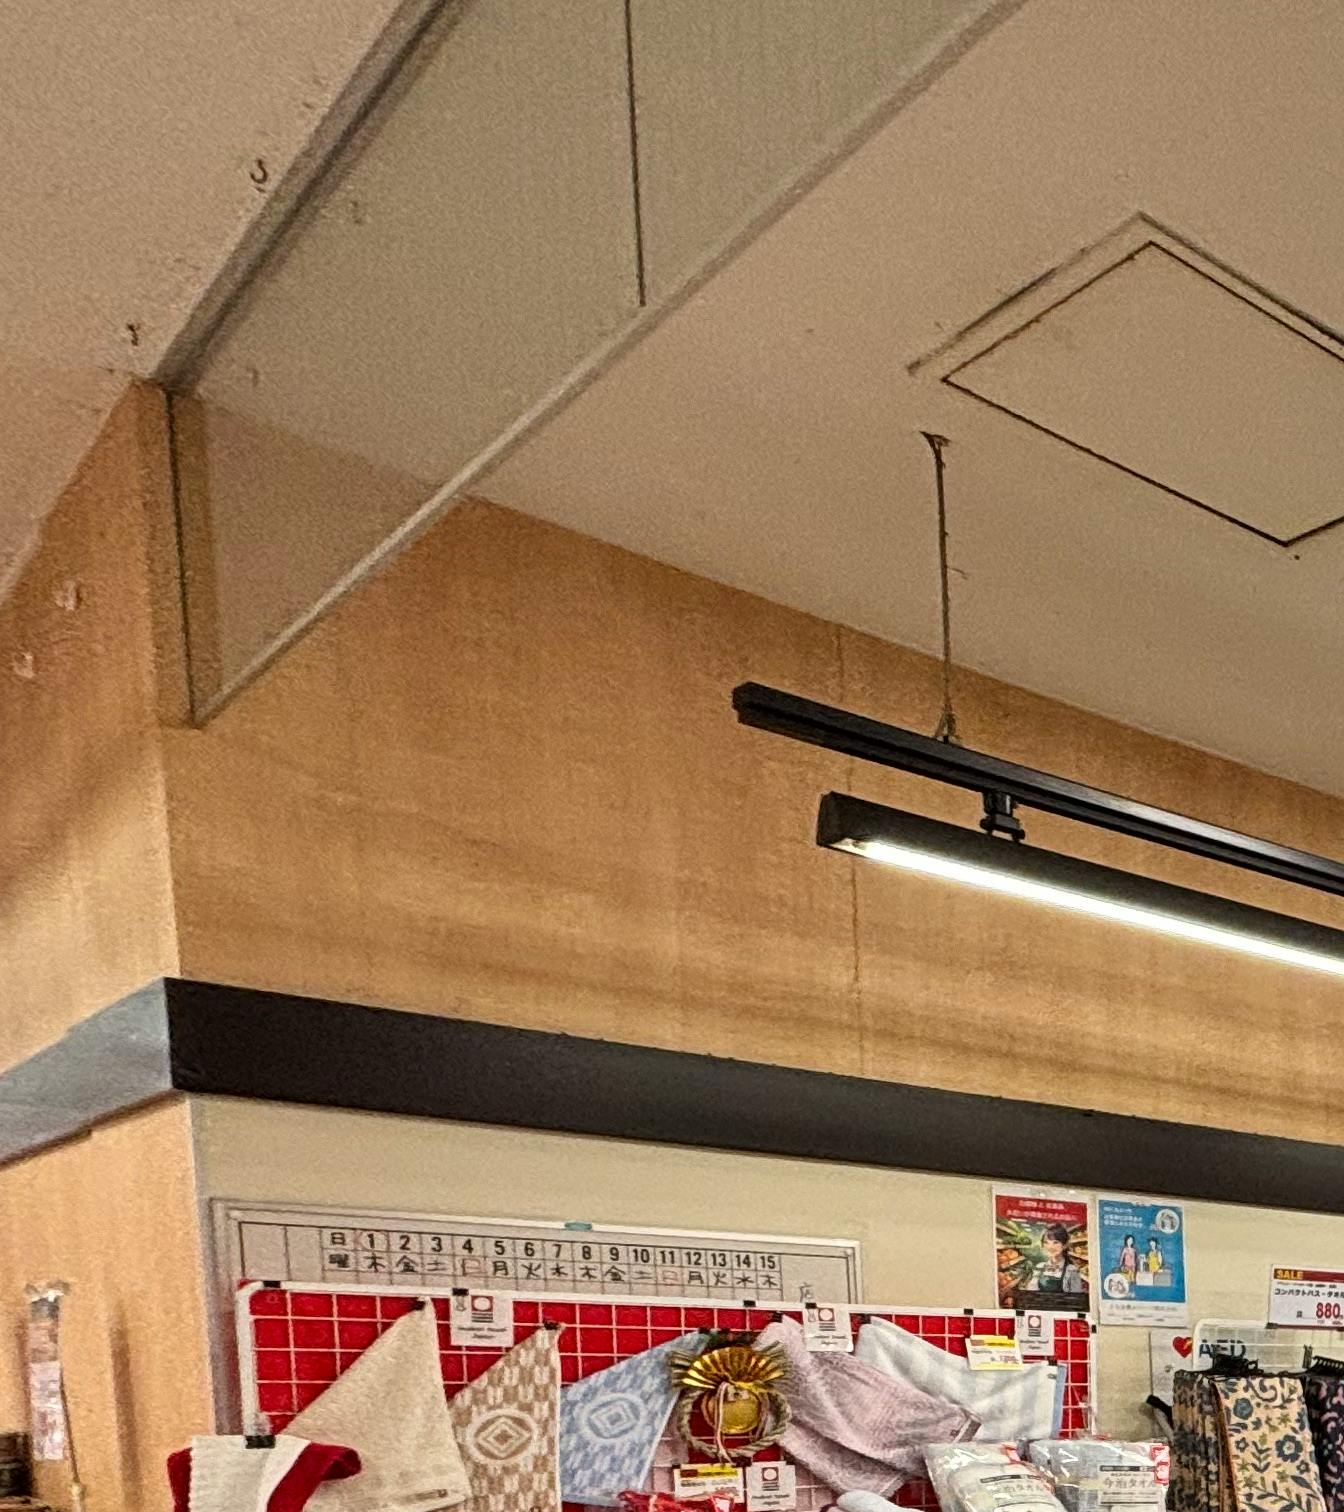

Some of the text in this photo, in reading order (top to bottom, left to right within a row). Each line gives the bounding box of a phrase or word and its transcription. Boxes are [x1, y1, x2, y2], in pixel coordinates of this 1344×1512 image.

[330, 1233, 776, 1269] 日 1 2 3 4 5 6 7 8 9 10 11 12 13 14 15
[1276, 1270, 1304, 1280] SALE
[1316, 1302, 1341, 1319] 880
